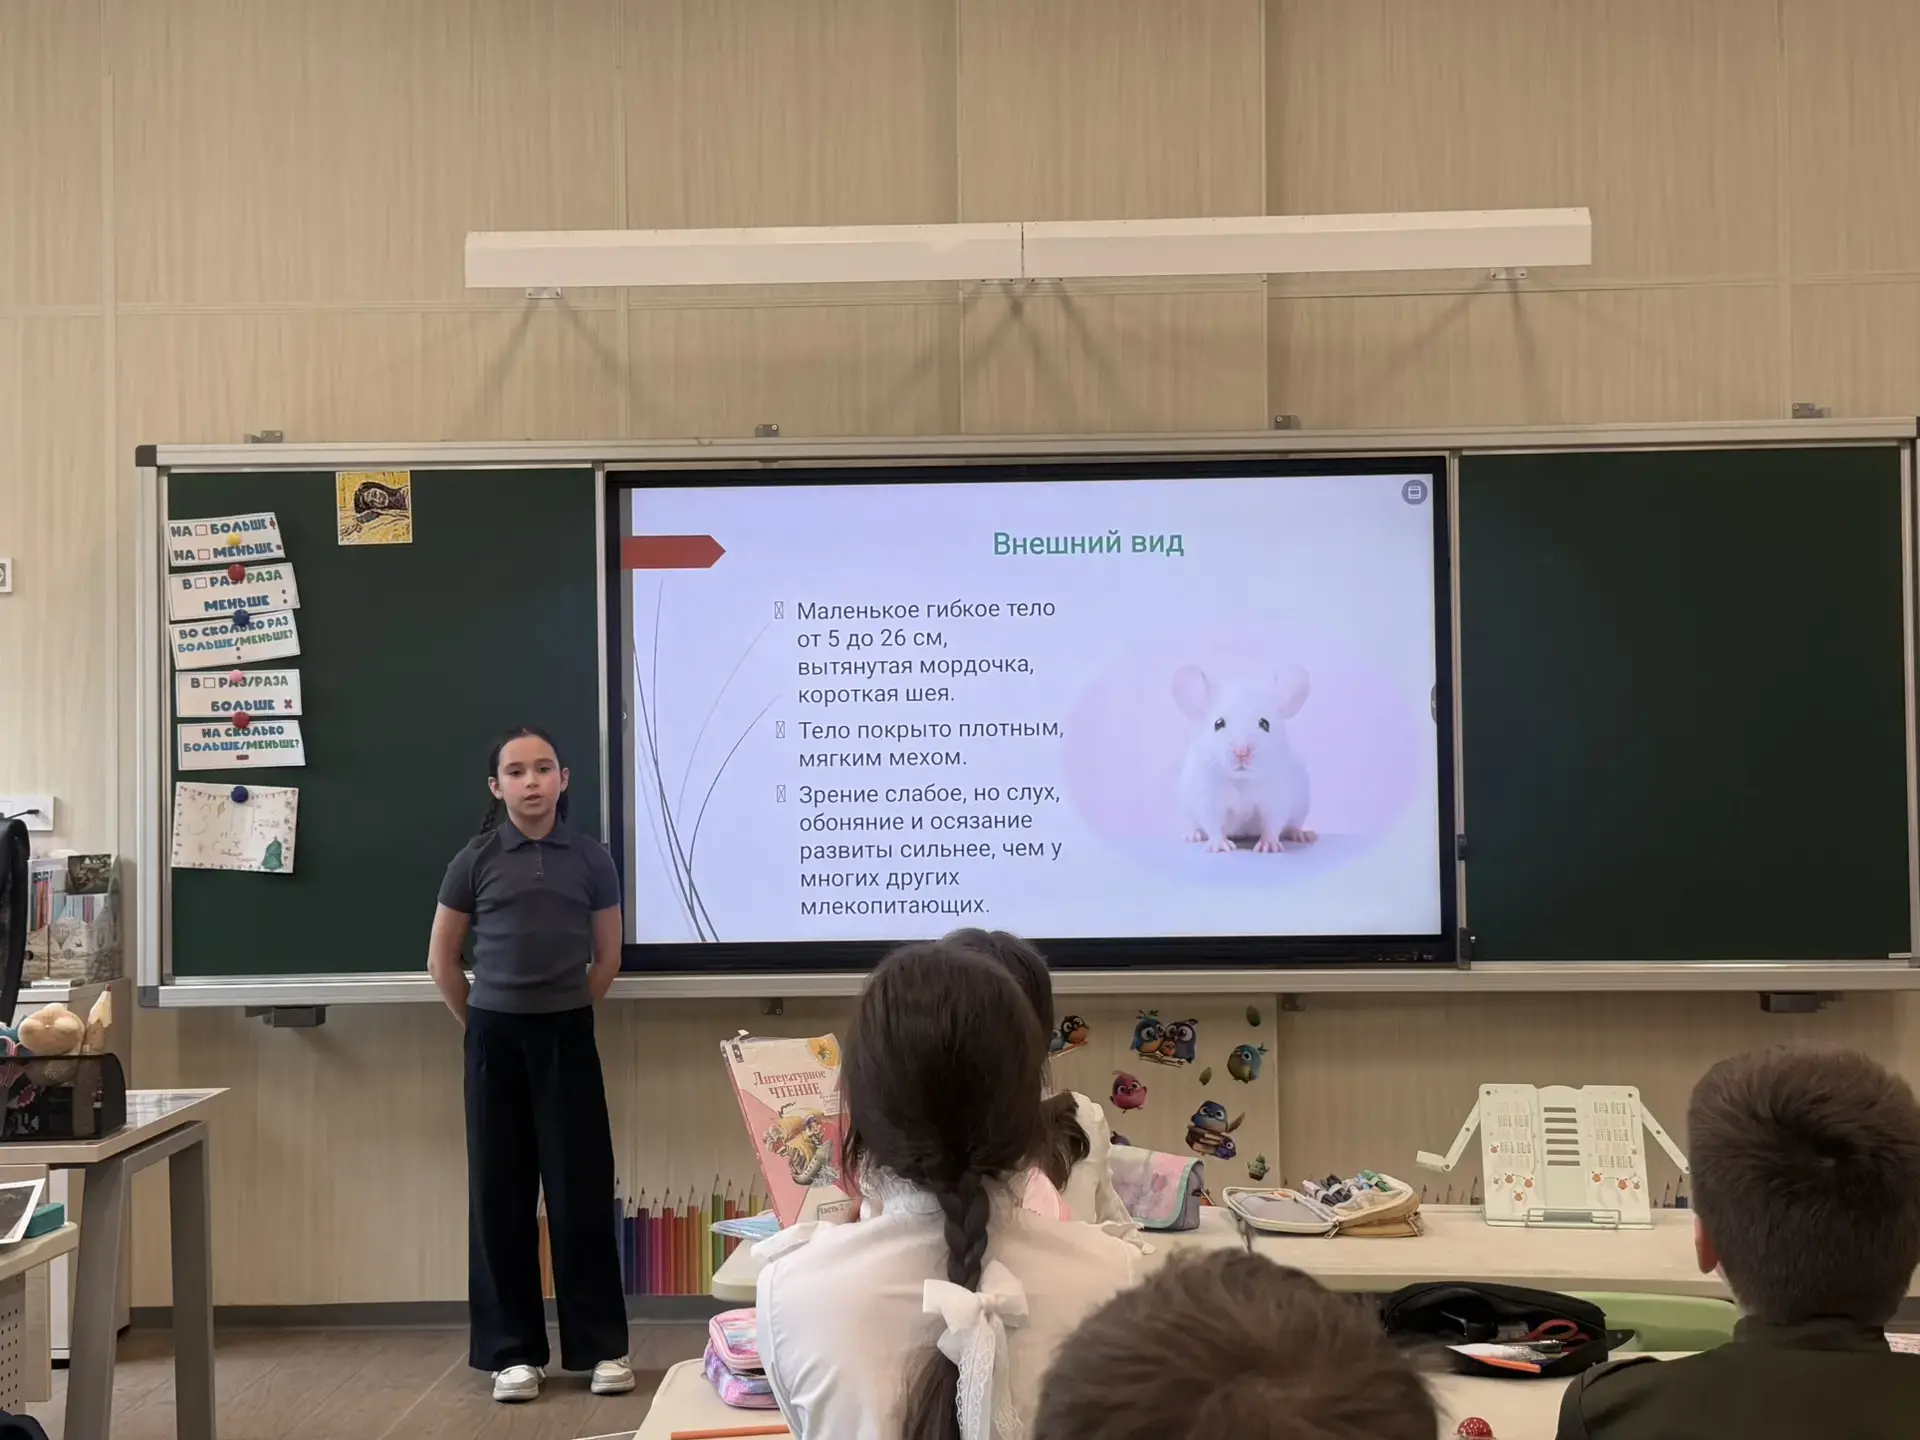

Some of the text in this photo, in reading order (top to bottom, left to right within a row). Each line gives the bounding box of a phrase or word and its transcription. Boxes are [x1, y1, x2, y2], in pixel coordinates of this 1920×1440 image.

[171, 518, 268, 538] НА БОЛЬШЕ
[174, 542, 274, 561] НА МЕНЬШЕ
[994, 530, 1184, 557] Внешний вид
[183, 578, 192, 590] В
[204, 595, 270, 612] МЕНЬШЕ
[798, 599, 1055, 620] Маленькое гибкое тело
[179, 628, 198, 639] ВО
[267, 615, 289, 627] РАЗ
[798, 629, 947, 651] от 5 до 26 см,
[799, 659, 1033, 679] вытянутая мордочка,
[191, 678, 200, 688] В
[211, 700, 275, 711] БОЛЬШЕ
[799, 688, 954, 707] короткая шея.
[202, 728, 221, 738] НА
[798, 722, 1064, 742] Тело покрыто плотным,
[800, 752, 966, 767] мягким мехом.
[799, 783, 1059, 807] Зрение слабое, но слух,
[800, 812, 1032, 831] обоняние и осязание
[801, 842, 1062, 862] развиты сильнее, чем у
[801, 872, 959, 891] многих других
[801, 898, 989, 917] млекопитающих.
[753, 1070, 826, 1086] Литературное
[769, 1083, 821, 1098] ЧТЕНИЕ
